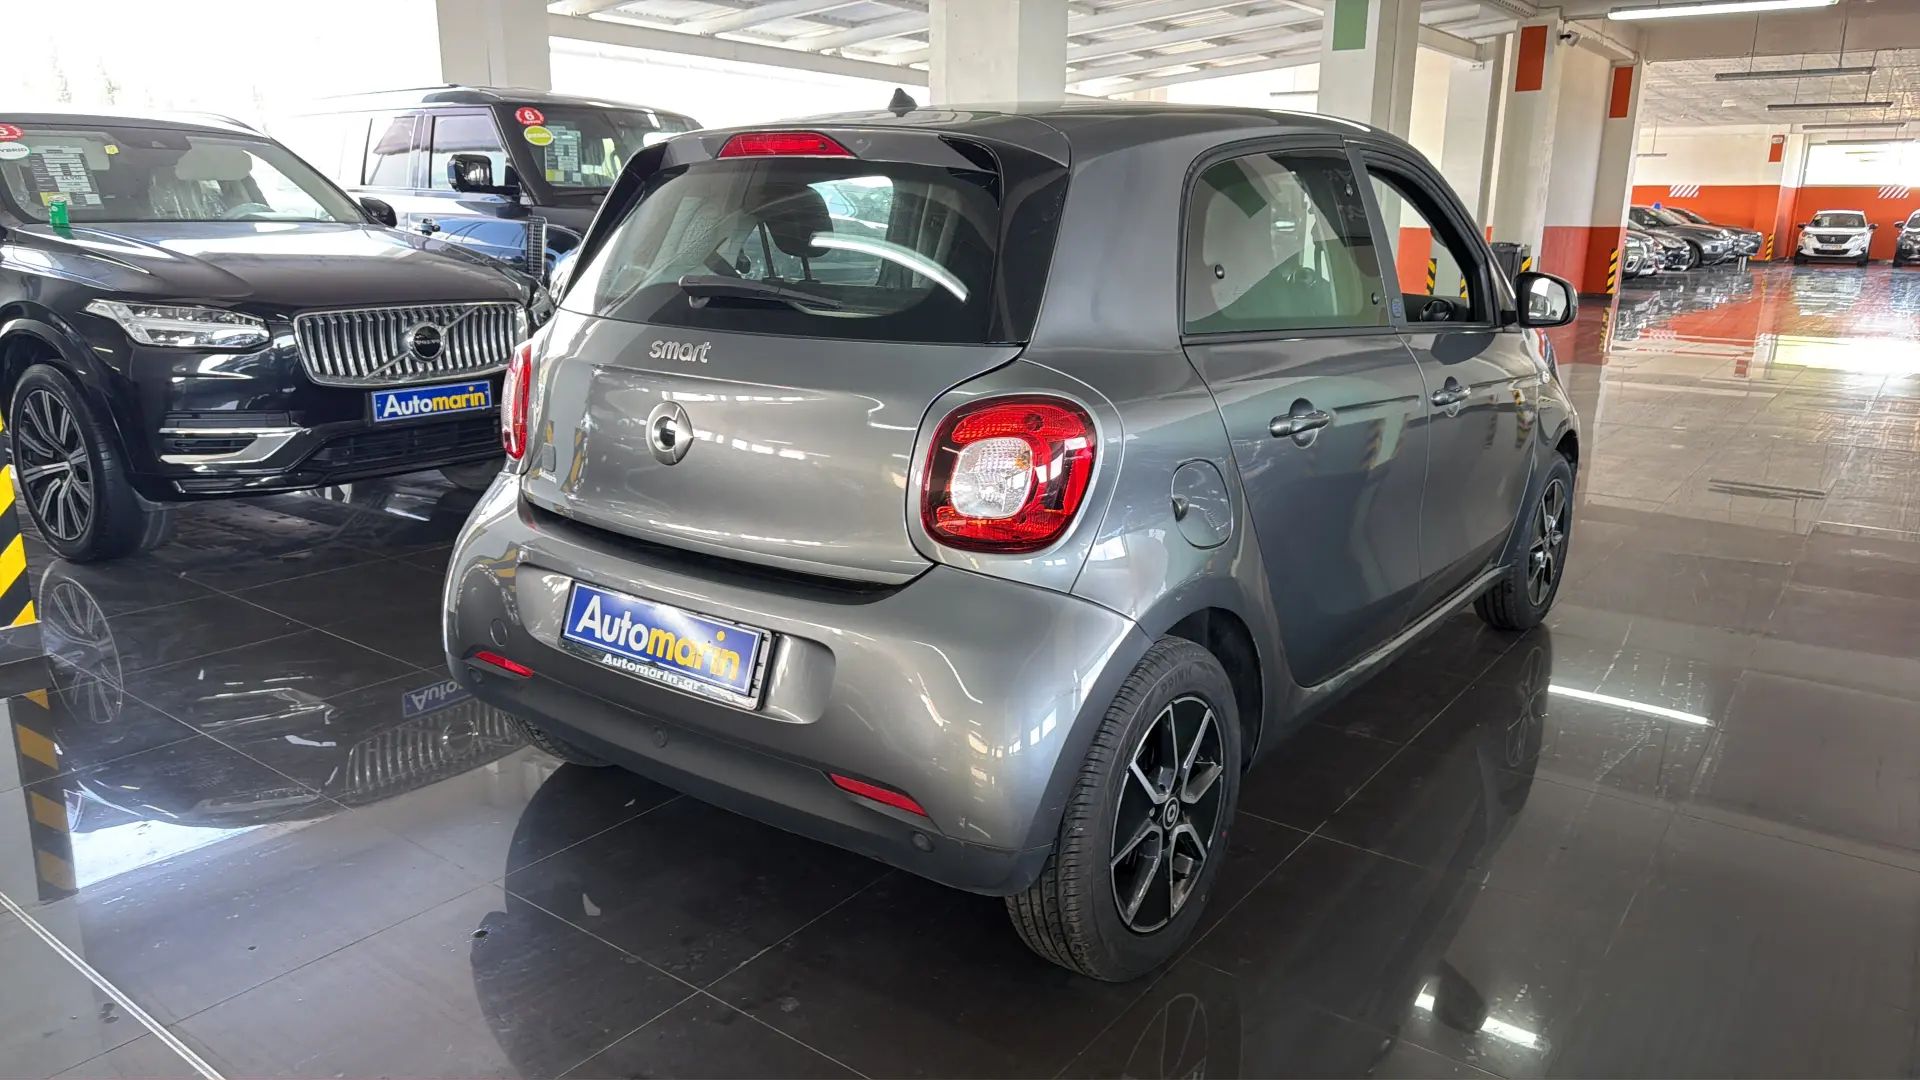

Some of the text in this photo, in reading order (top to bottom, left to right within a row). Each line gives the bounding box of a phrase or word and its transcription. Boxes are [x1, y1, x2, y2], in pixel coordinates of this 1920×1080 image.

[524, 110, 535, 121] 6
[649, 340, 712, 363] smart
[383, 386, 486, 418] Automarin
[575, 594, 741, 681] Automarin
[602, 653, 701, 691] Automarin.gr
